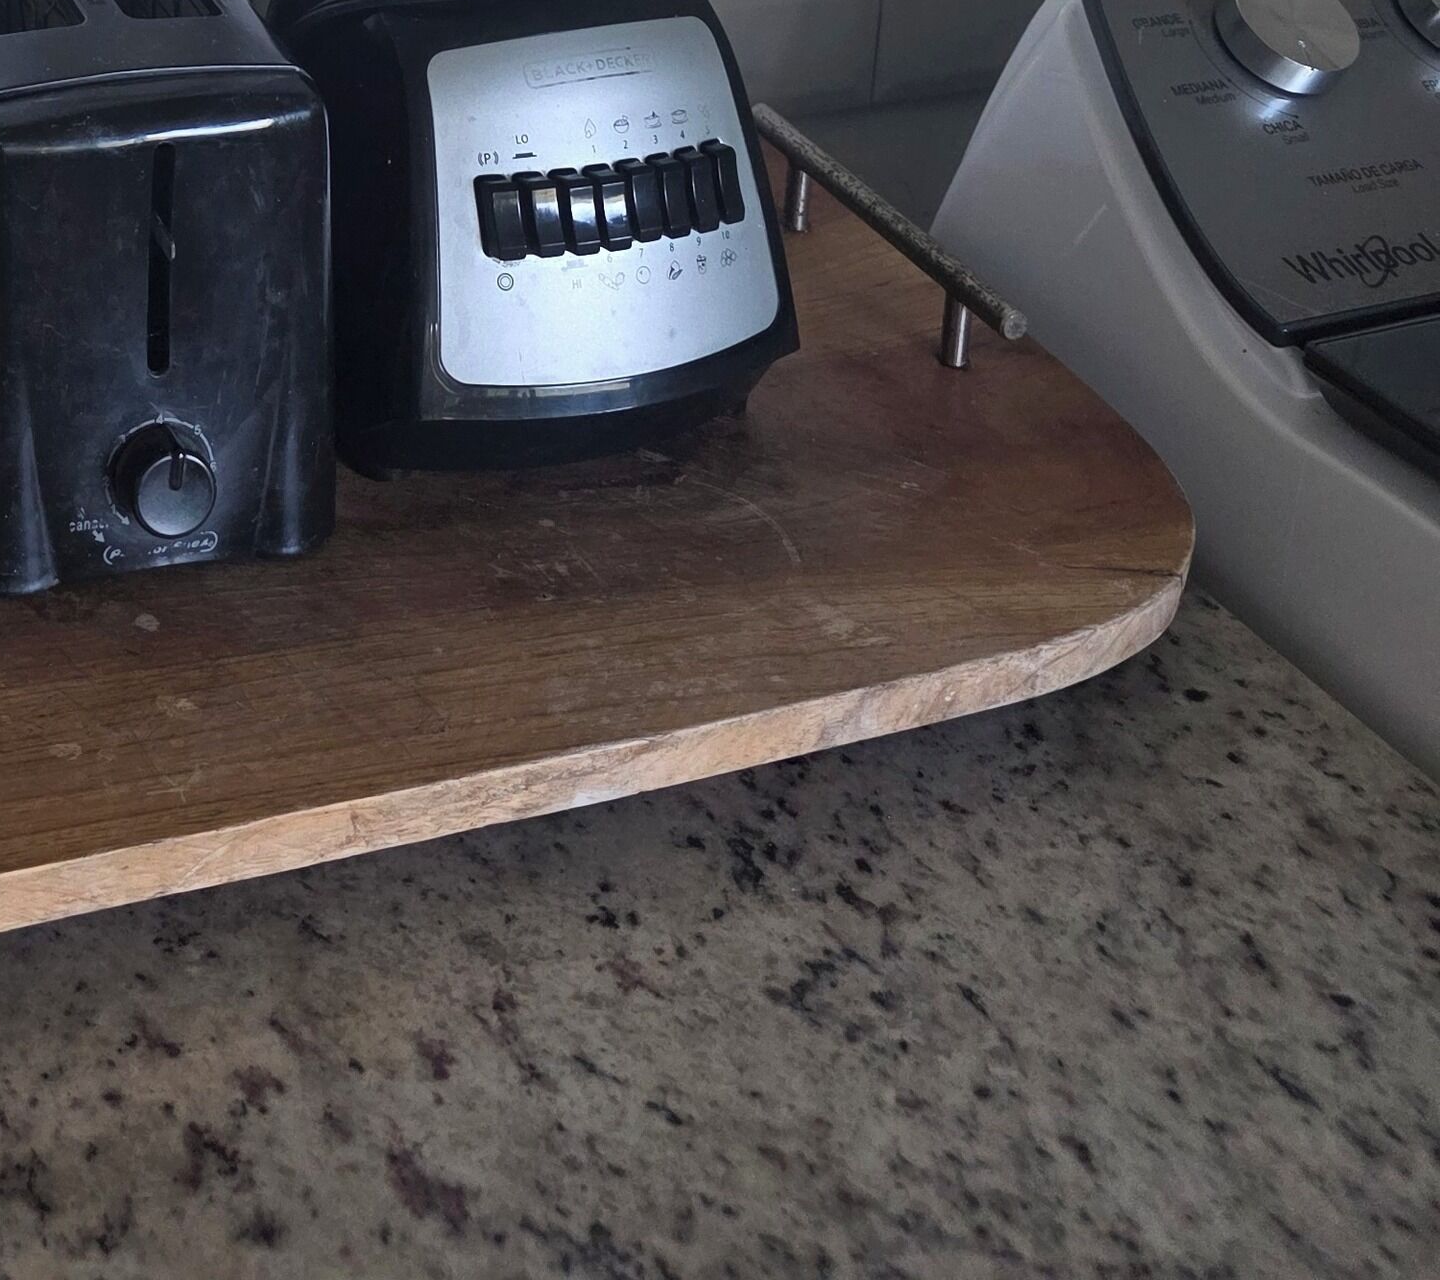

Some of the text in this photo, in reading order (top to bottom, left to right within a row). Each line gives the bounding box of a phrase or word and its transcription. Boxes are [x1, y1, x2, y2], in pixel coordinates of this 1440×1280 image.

[1171, 79, 1228, 96] MEDIANA
[1262, 118, 1305, 135] CHICA
[515, 134, 529, 145] LO
[1307, 159, 1424, 187] TAMAÑO DE CARGA
[721, 231, 730, 240] 10
[1282, 232, 1440, 288] Whirlpool
[156, 413, 163, 424] 4
[194, 424, 202, 435] 5
[210, 461, 217, 472] 6
